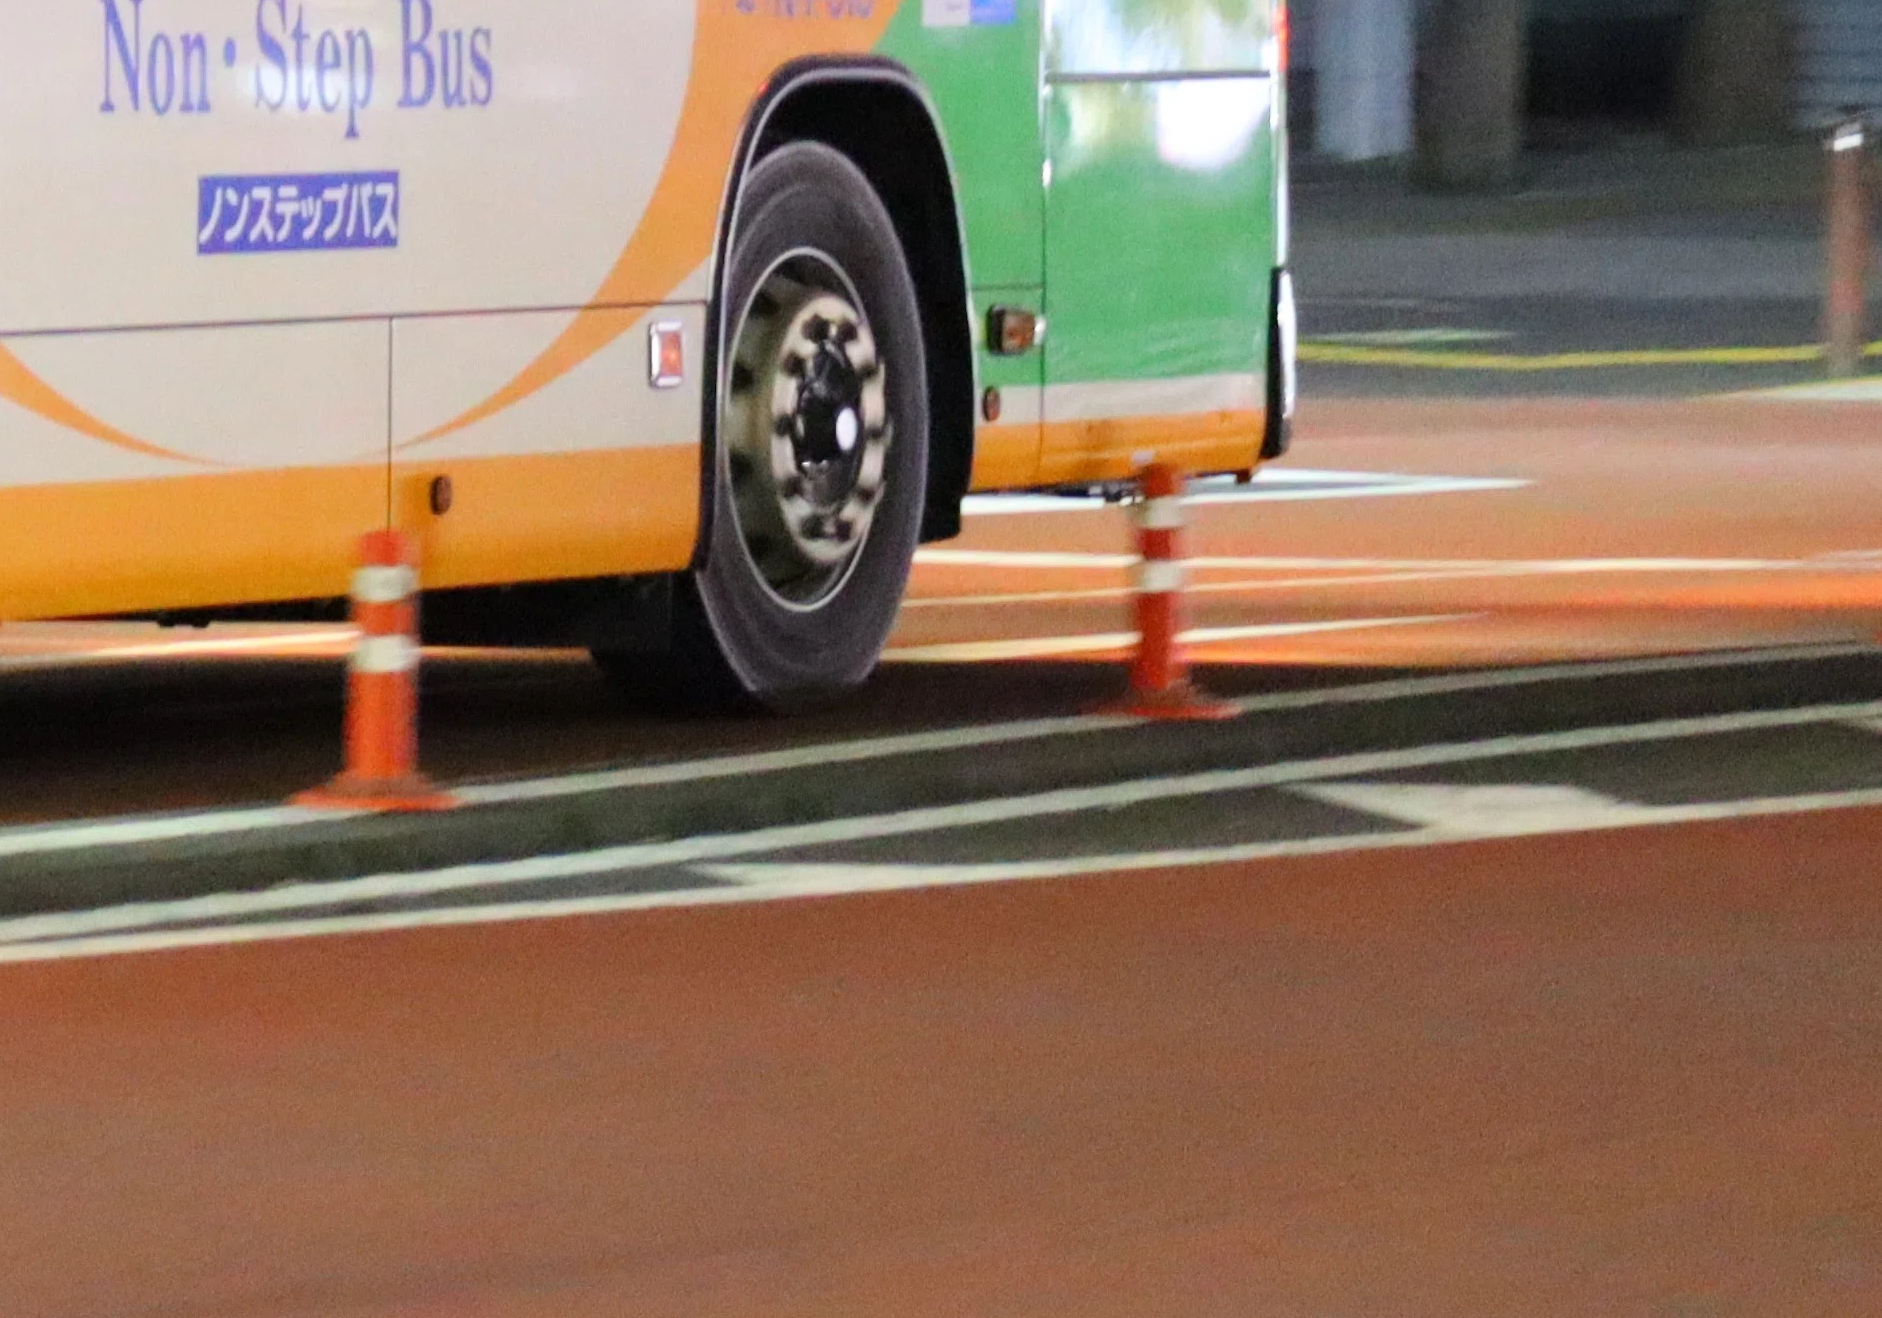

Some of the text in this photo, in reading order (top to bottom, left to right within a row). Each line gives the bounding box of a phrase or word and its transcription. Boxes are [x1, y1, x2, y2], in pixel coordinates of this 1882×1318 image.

[199, 181, 398, 244] ノンステップバス
